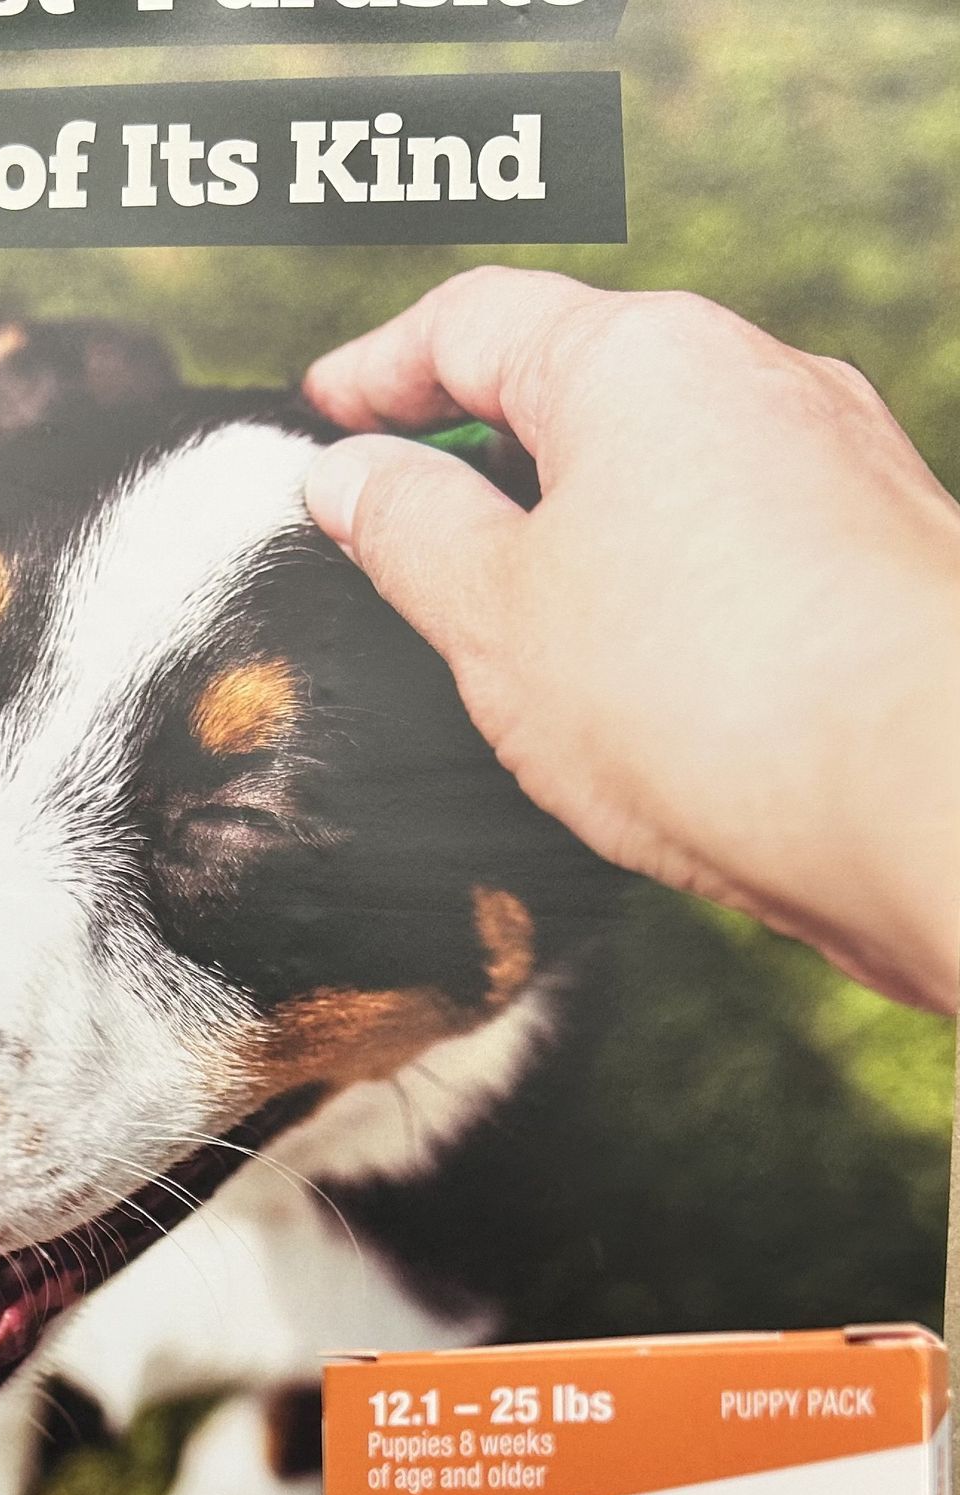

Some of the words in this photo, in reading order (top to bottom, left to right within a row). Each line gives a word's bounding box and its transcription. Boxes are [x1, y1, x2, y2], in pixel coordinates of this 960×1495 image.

[119, 122, 259, 208] Its
[290, 113, 545, 204] Kind
[368, 1390, 439, 1426] 12.1
[490, 1388, 540, 1423] 25
[552, 1384, 615, 1422] lbs
[720, 1388, 801, 1420] PUPPY
[806, 1387, 876, 1417] PACK
[368, 1431, 453, 1459] Puppies
[459, 1432, 474, 1455] 8
[480, 1431, 555, 1455] weeks
[368, 1464, 391, 1488] of
[394, 1469, 433, 1494] age
[440, 1463, 481, 1488] and
[487, 1462, 546, 1488] older
